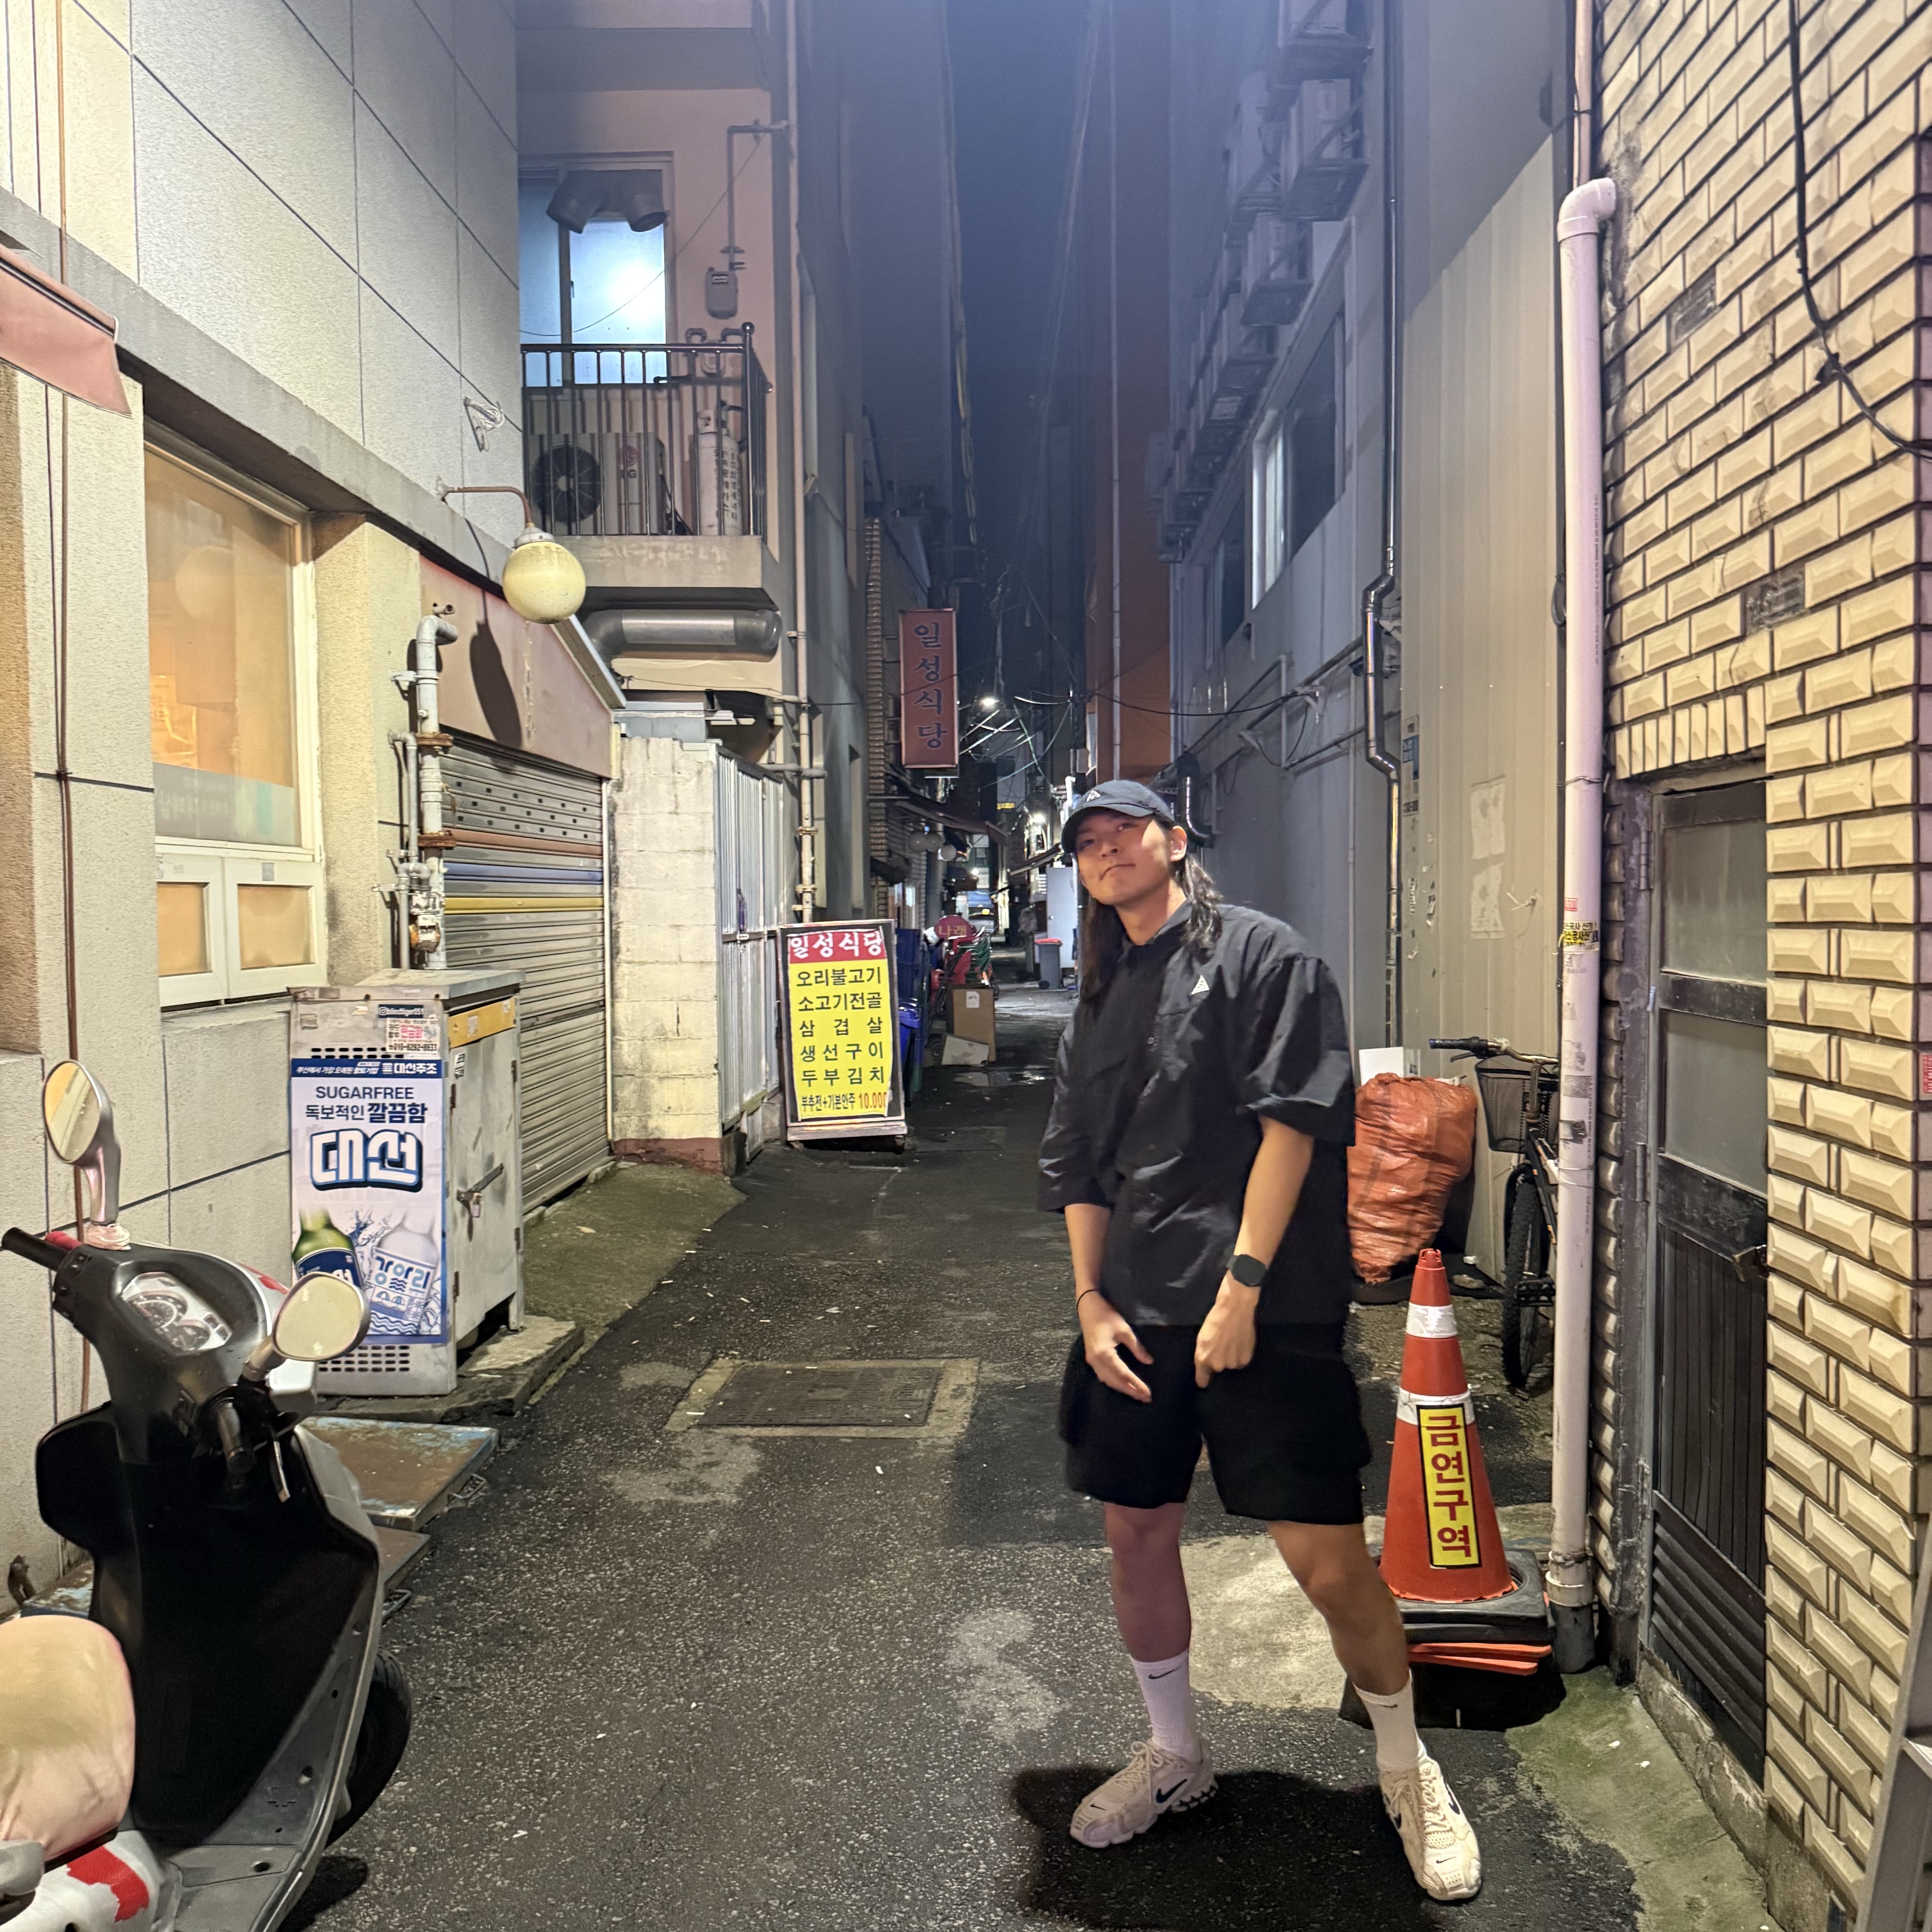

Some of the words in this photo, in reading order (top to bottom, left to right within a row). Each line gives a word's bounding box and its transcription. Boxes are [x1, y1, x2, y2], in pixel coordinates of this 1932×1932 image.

[911, 621, 947, 750] 일성식당
[790, 930, 883, 959] 일성식당
[796, 967, 881, 987] 오리불고기
[798, 992, 882, 1012] 소고기전골
[799, 1017, 883, 1038] 삼겹살
[800, 1041, 884, 1063] 생선구이
[394, 1063, 437, 1074] 대선주조
[801, 1066, 884, 1087] 두부김치
[316, 1086, 414, 1099] SUGARFREE
[305, 1104, 364, 1120] 독보적인
[368, 1103, 428, 1123] 깔끔함
[310, 1128, 423, 1192] 대선
[374, 1256, 430, 1289] 강알리
[1426, 1415, 1471, 1557] 금연구역
